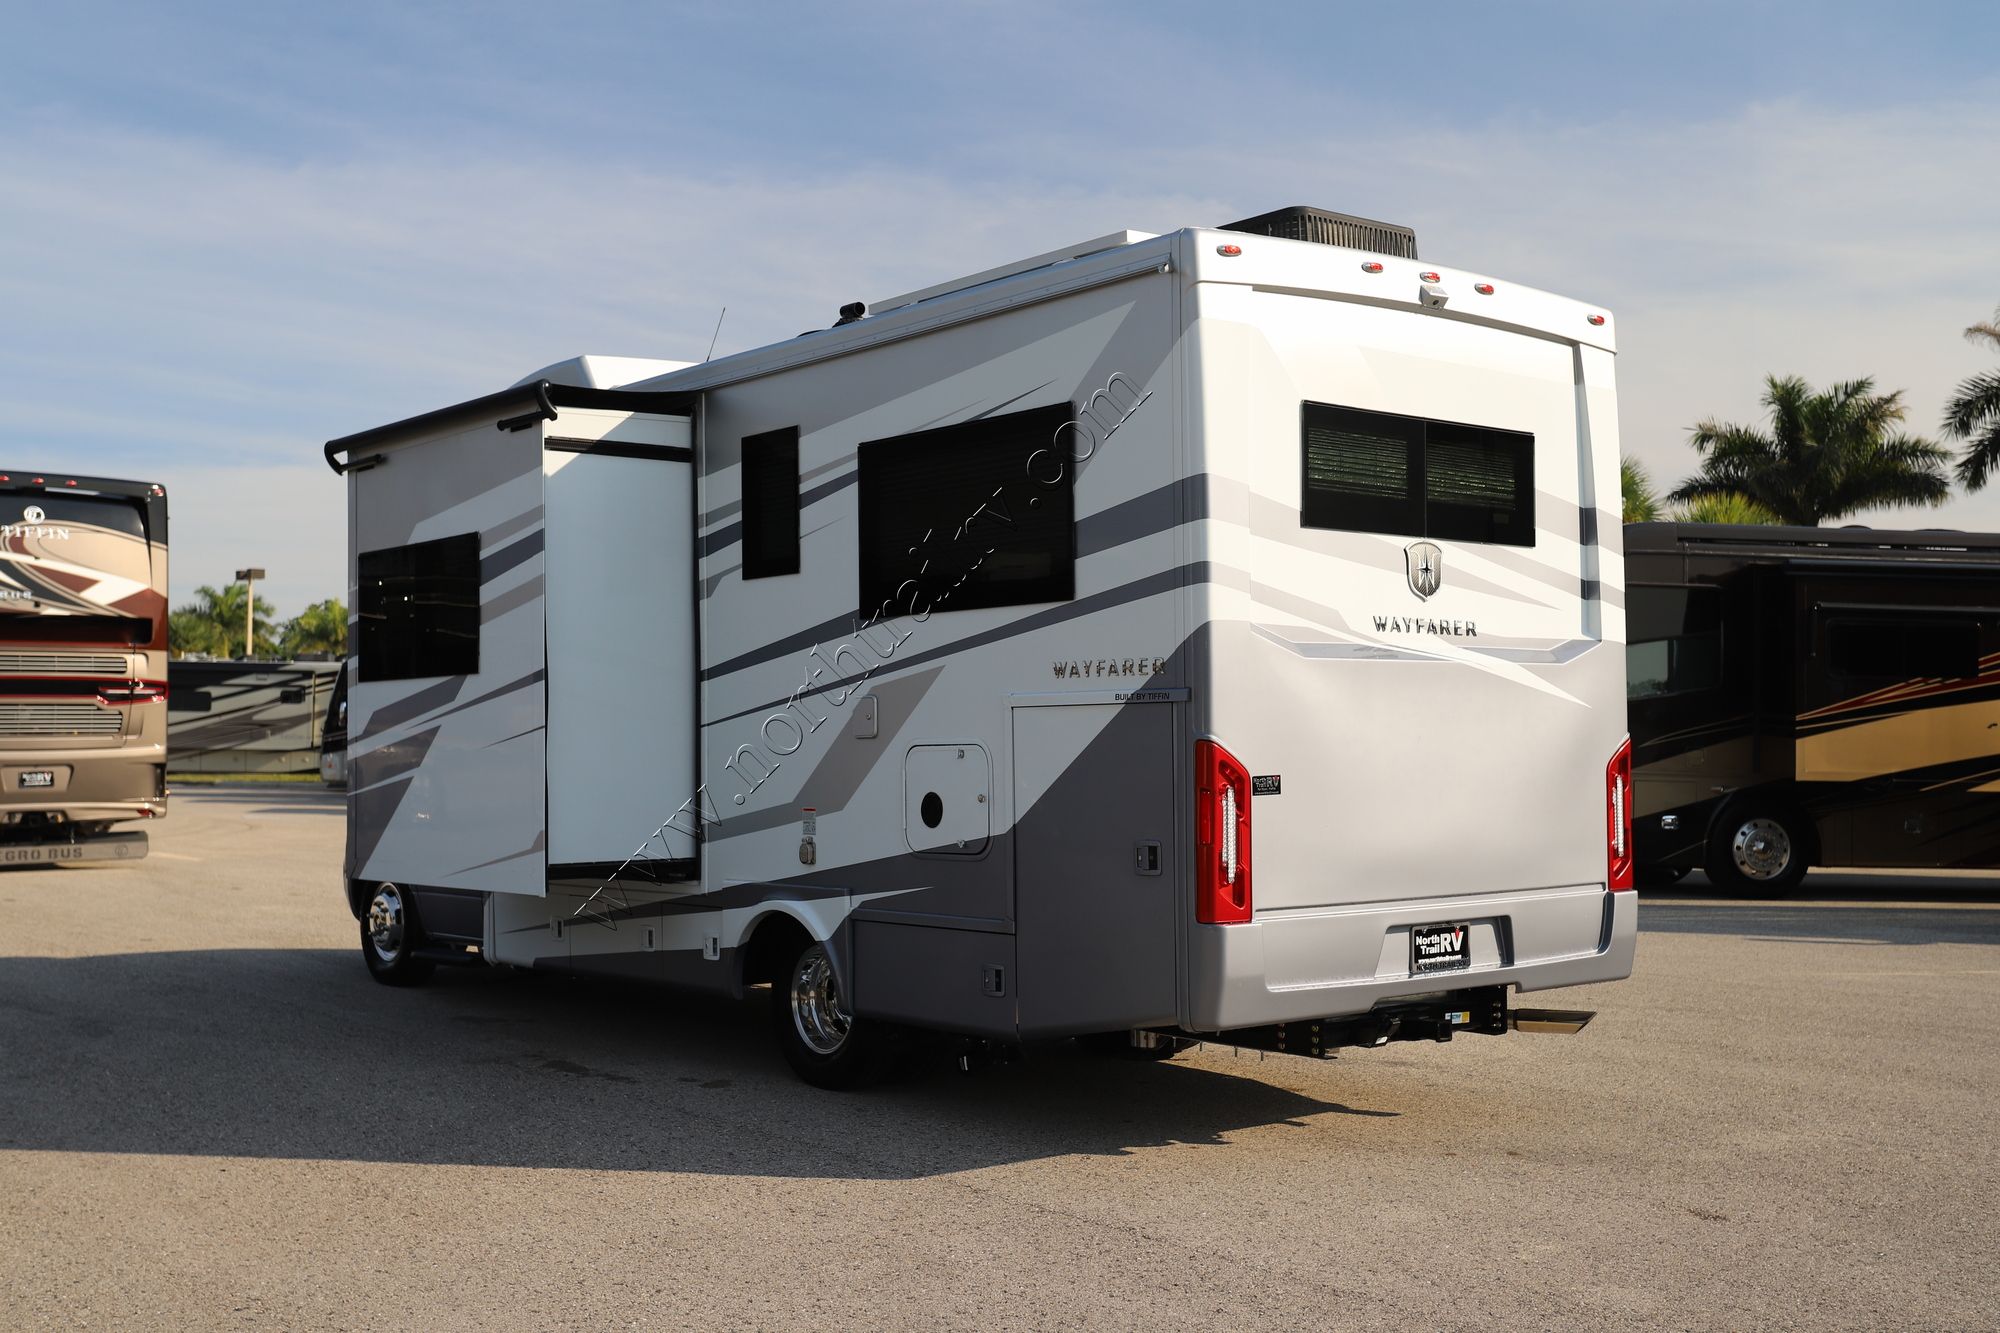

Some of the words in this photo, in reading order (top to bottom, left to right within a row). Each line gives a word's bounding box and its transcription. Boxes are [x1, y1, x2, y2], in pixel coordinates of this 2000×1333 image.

[1, 525, 69, 540] TIFFIN
[1373, 615, 1478, 637] WAYFARER
[1053, 657, 1167, 679] WAYFARER
[1115, 693, 1135, 701] BUILT
[1148, 692, 1170, 700] TIFFIN
[48, 847, 83, 859] BUS
[1415, 934, 1440, 946] North
[1440, 931, 1464, 953] RV
[1420, 944, 1440, 955] Trail
